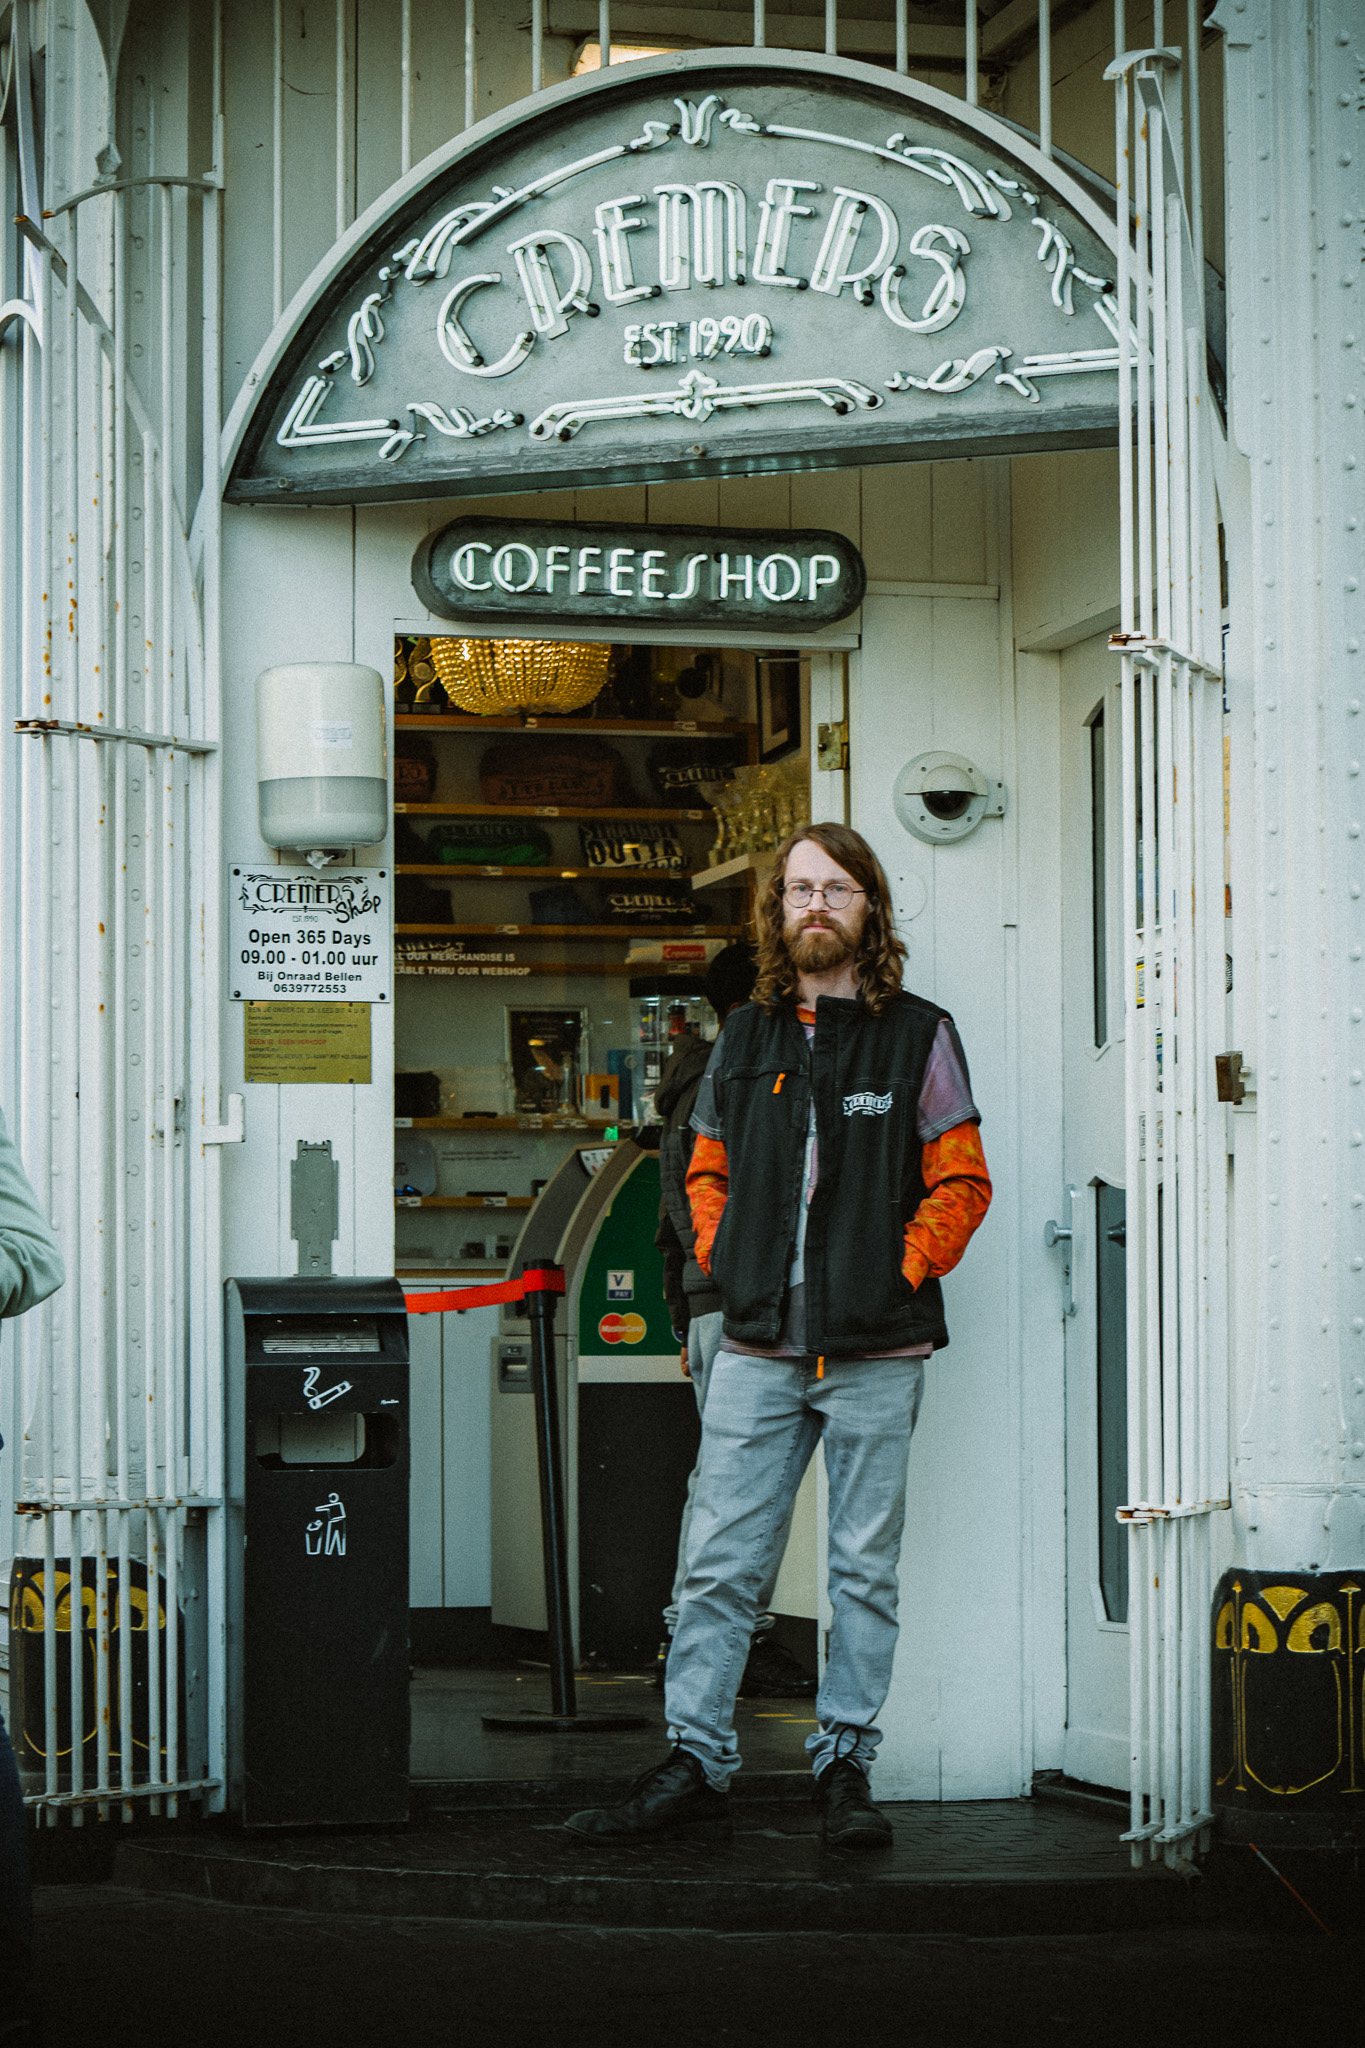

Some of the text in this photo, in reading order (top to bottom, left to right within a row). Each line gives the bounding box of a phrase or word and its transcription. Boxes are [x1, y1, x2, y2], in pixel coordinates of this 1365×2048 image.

[436, 178, 970, 377] CREMERS
[256, 883, 381, 924] CREMERS Shop
[249, 929, 371, 948] Open 365 Days
[241, 950, 285, 964] 09.00
[302, 951, 346, 965] 01.00
[352, 955, 378, 966] uur
[406, 952, 428, 961] OUR
[430, 952, 503, 962] MERCHANDISE
[505, 953, 515, 961] IS
[258, 971, 362, 982] Bij Onraad Bellen
[427, 966, 455, 975] THRU
[457, 967, 479, 976] OUR
[481, 967, 531, 976] WEBSHOP
[273, 984, 347, 993] 0639772553
[612, 1274, 624, 1287] V
[601, 1325, 643, 1333] MasterCard
